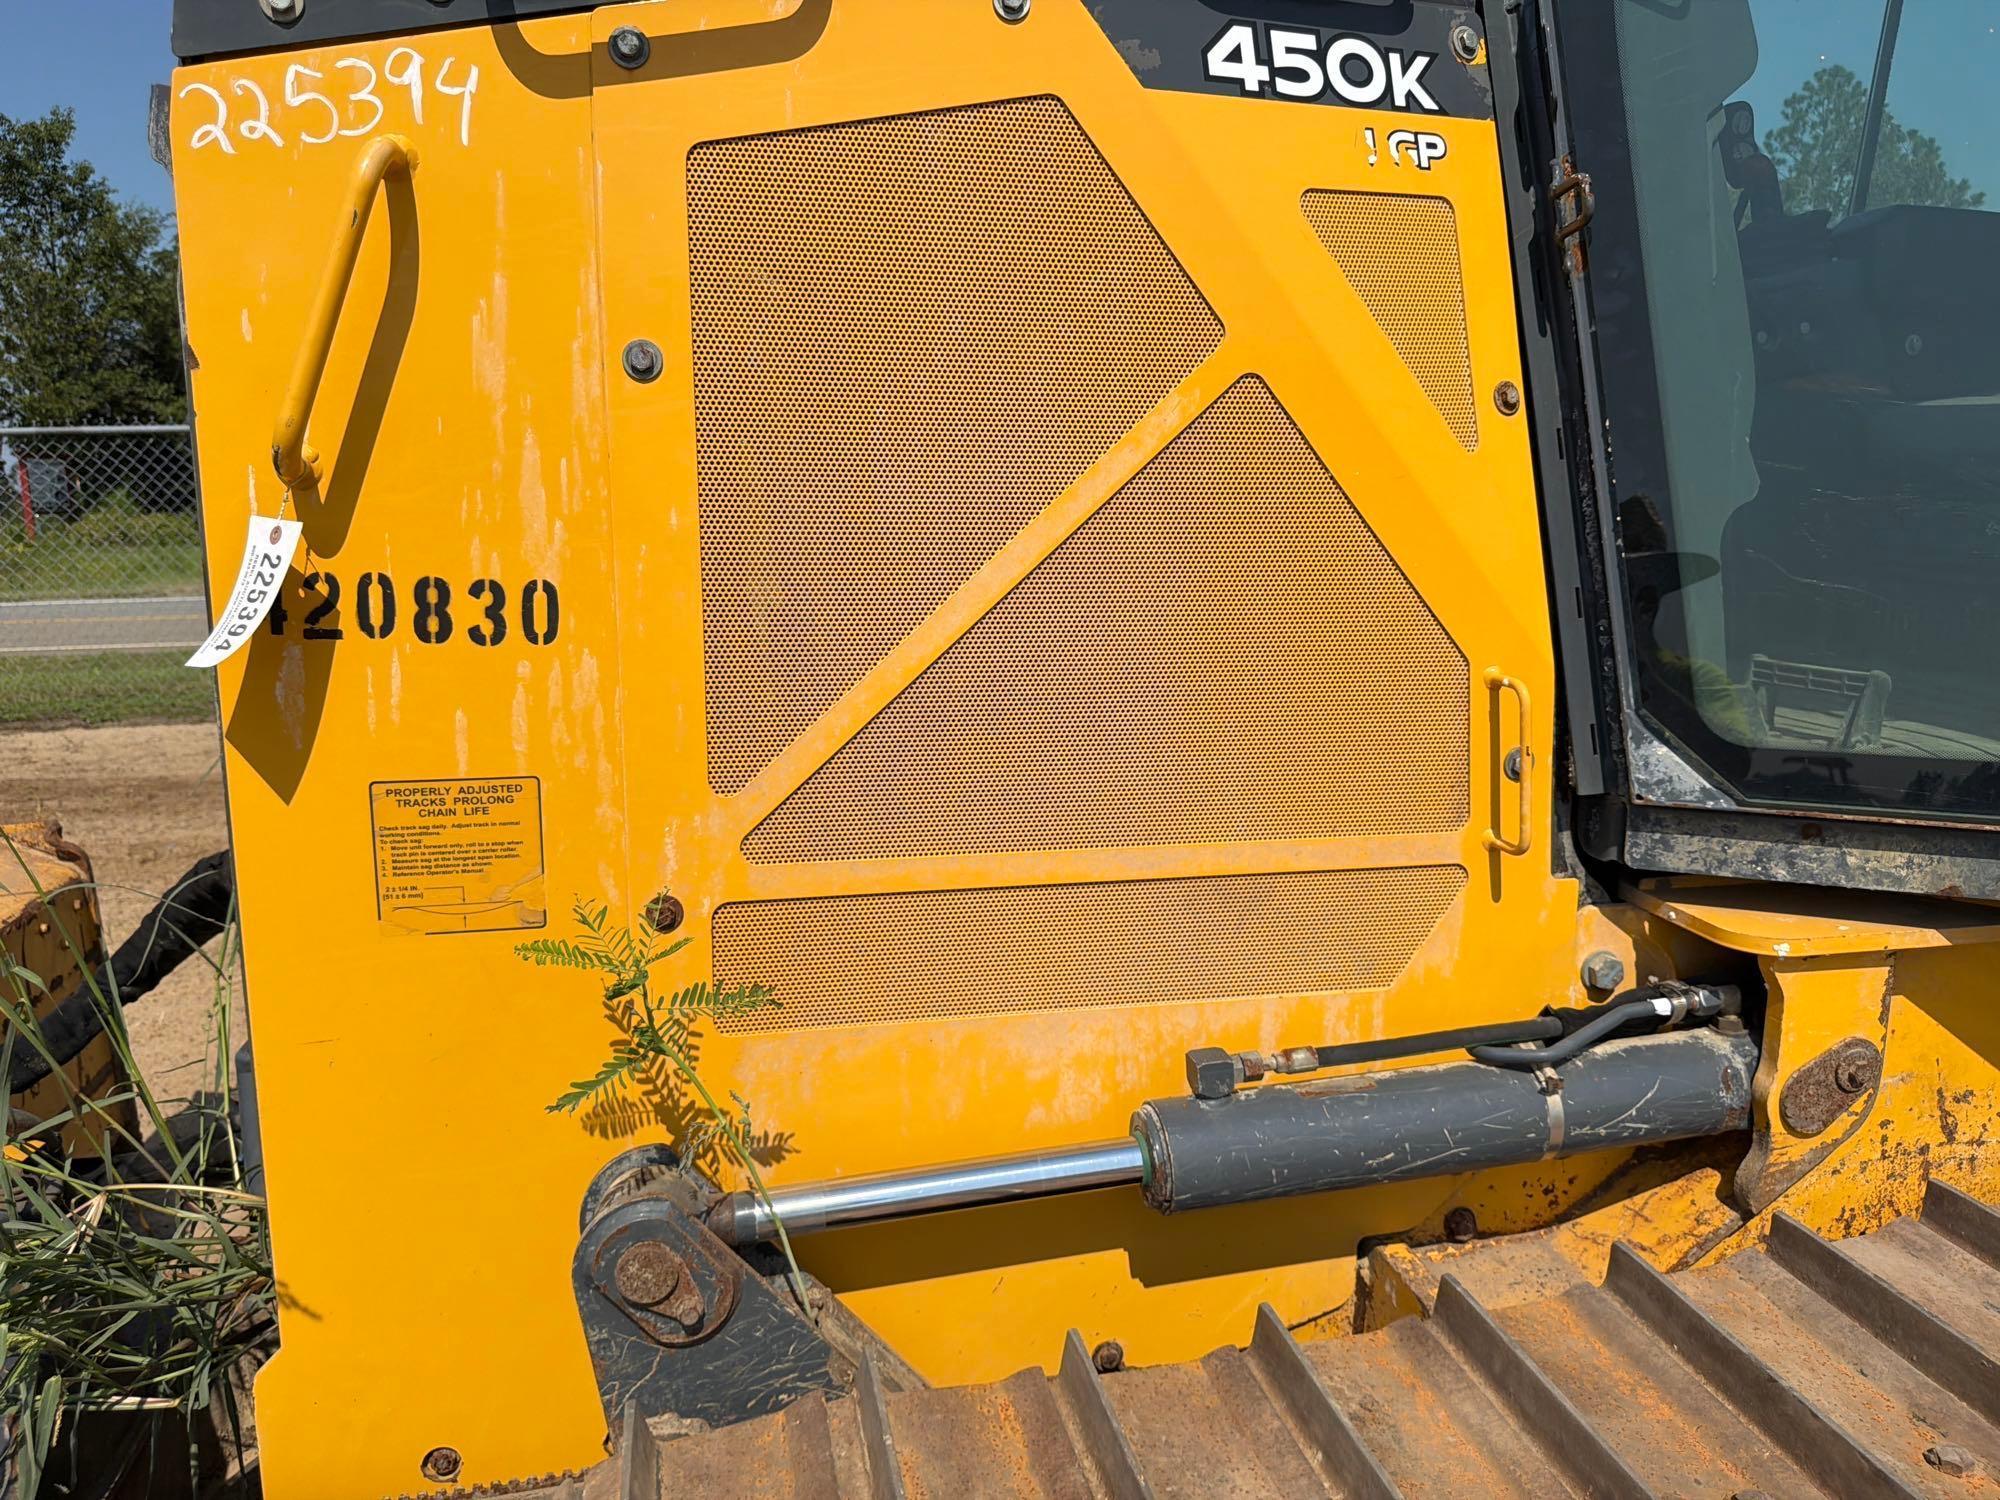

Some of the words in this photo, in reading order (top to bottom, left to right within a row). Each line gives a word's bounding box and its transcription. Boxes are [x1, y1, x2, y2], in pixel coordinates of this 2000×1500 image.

[1204, 22, 1442, 112] 450K
[178, 46, 479, 154] 225394
[214, 552, 282, 652] 225394
[386, 787, 451, 797] PROPERLY
[458, 784, 522, 794] ADJUSTED
[396, 798, 446, 807] TRACKS
[454, 795, 514, 805] PROLONG
[419, 809, 456, 817] CHAIN
[464, 807, 489, 815] LIFE
